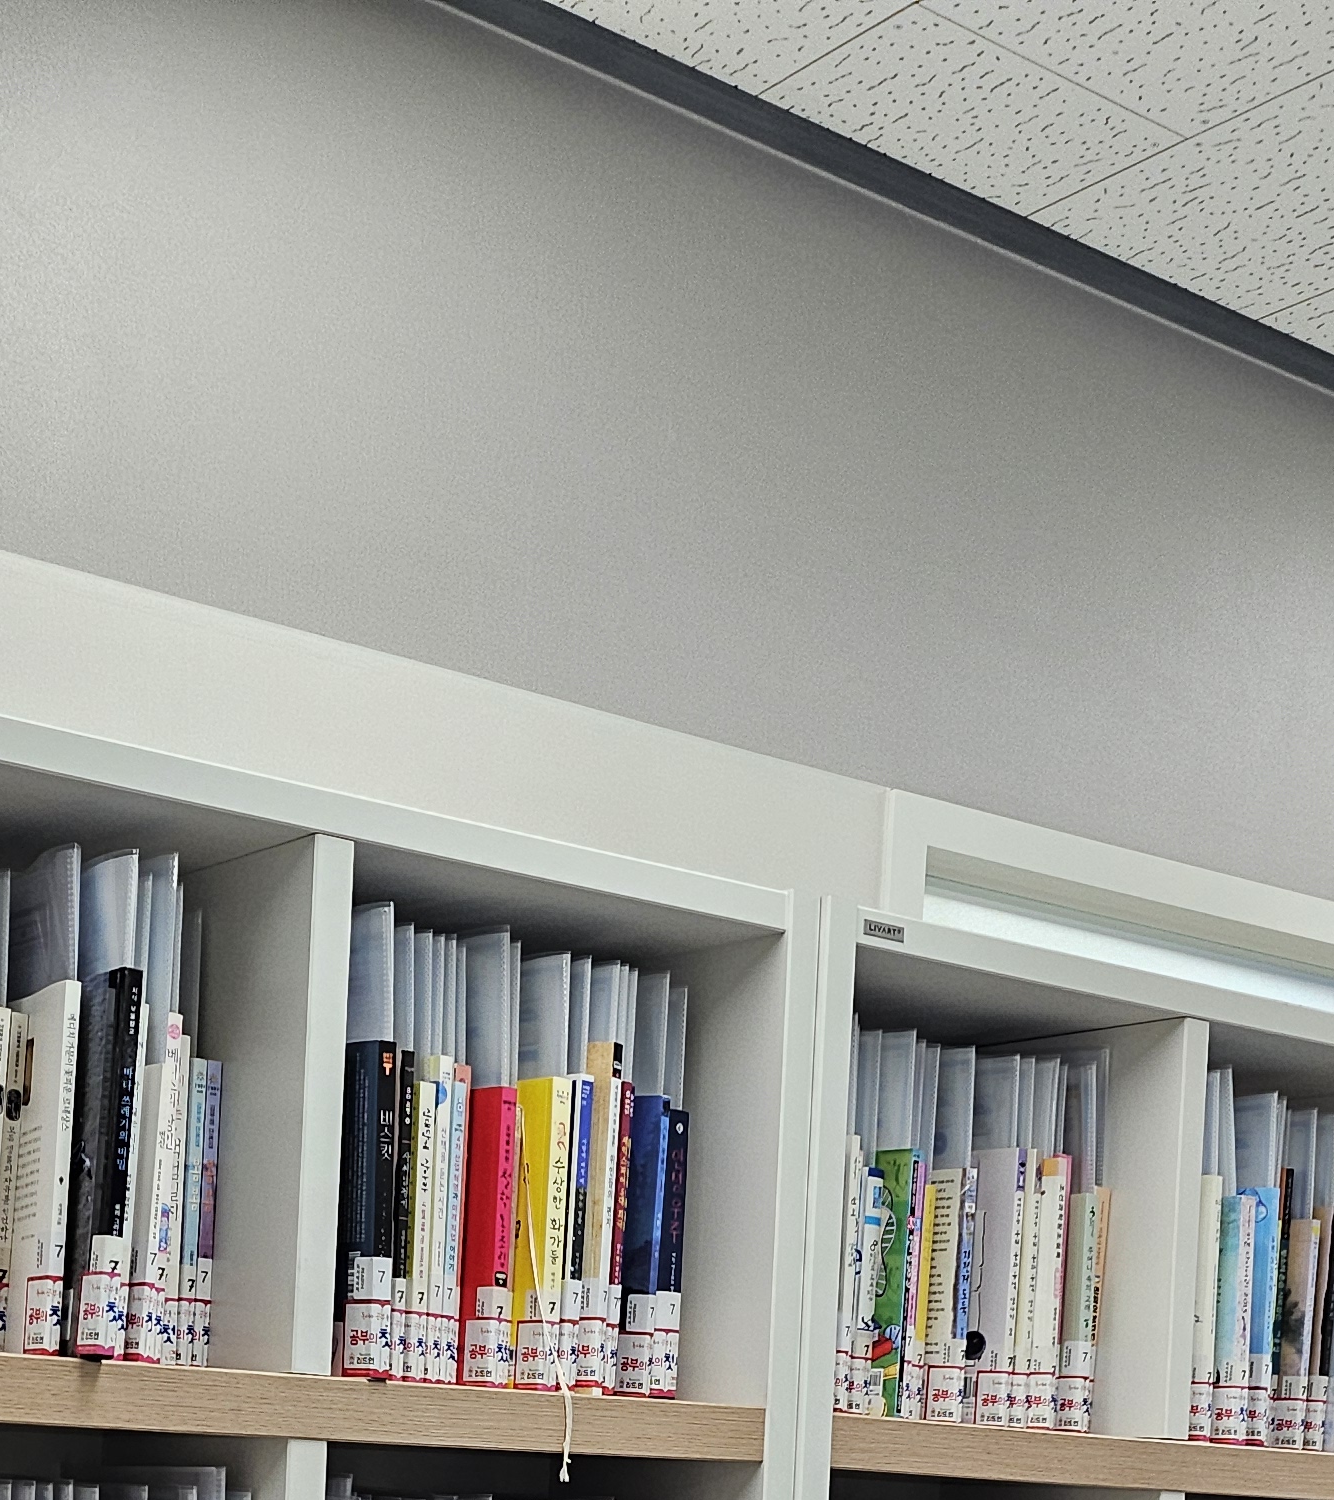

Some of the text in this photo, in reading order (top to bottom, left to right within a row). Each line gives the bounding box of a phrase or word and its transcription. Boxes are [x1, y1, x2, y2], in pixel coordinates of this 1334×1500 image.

[122, 1066, 134, 1092] 바다
[379, 1109, 393, 1161] 비스킷
[116, 1146, 128, 1171] 비밀
[548, 1157, 565, 1266] 수상한 화가들
[376, 1270, 385, 1283] 7
[83, 1303, 105, 1320] 공부의
[468, 1343, 496, 1360] 공부의
